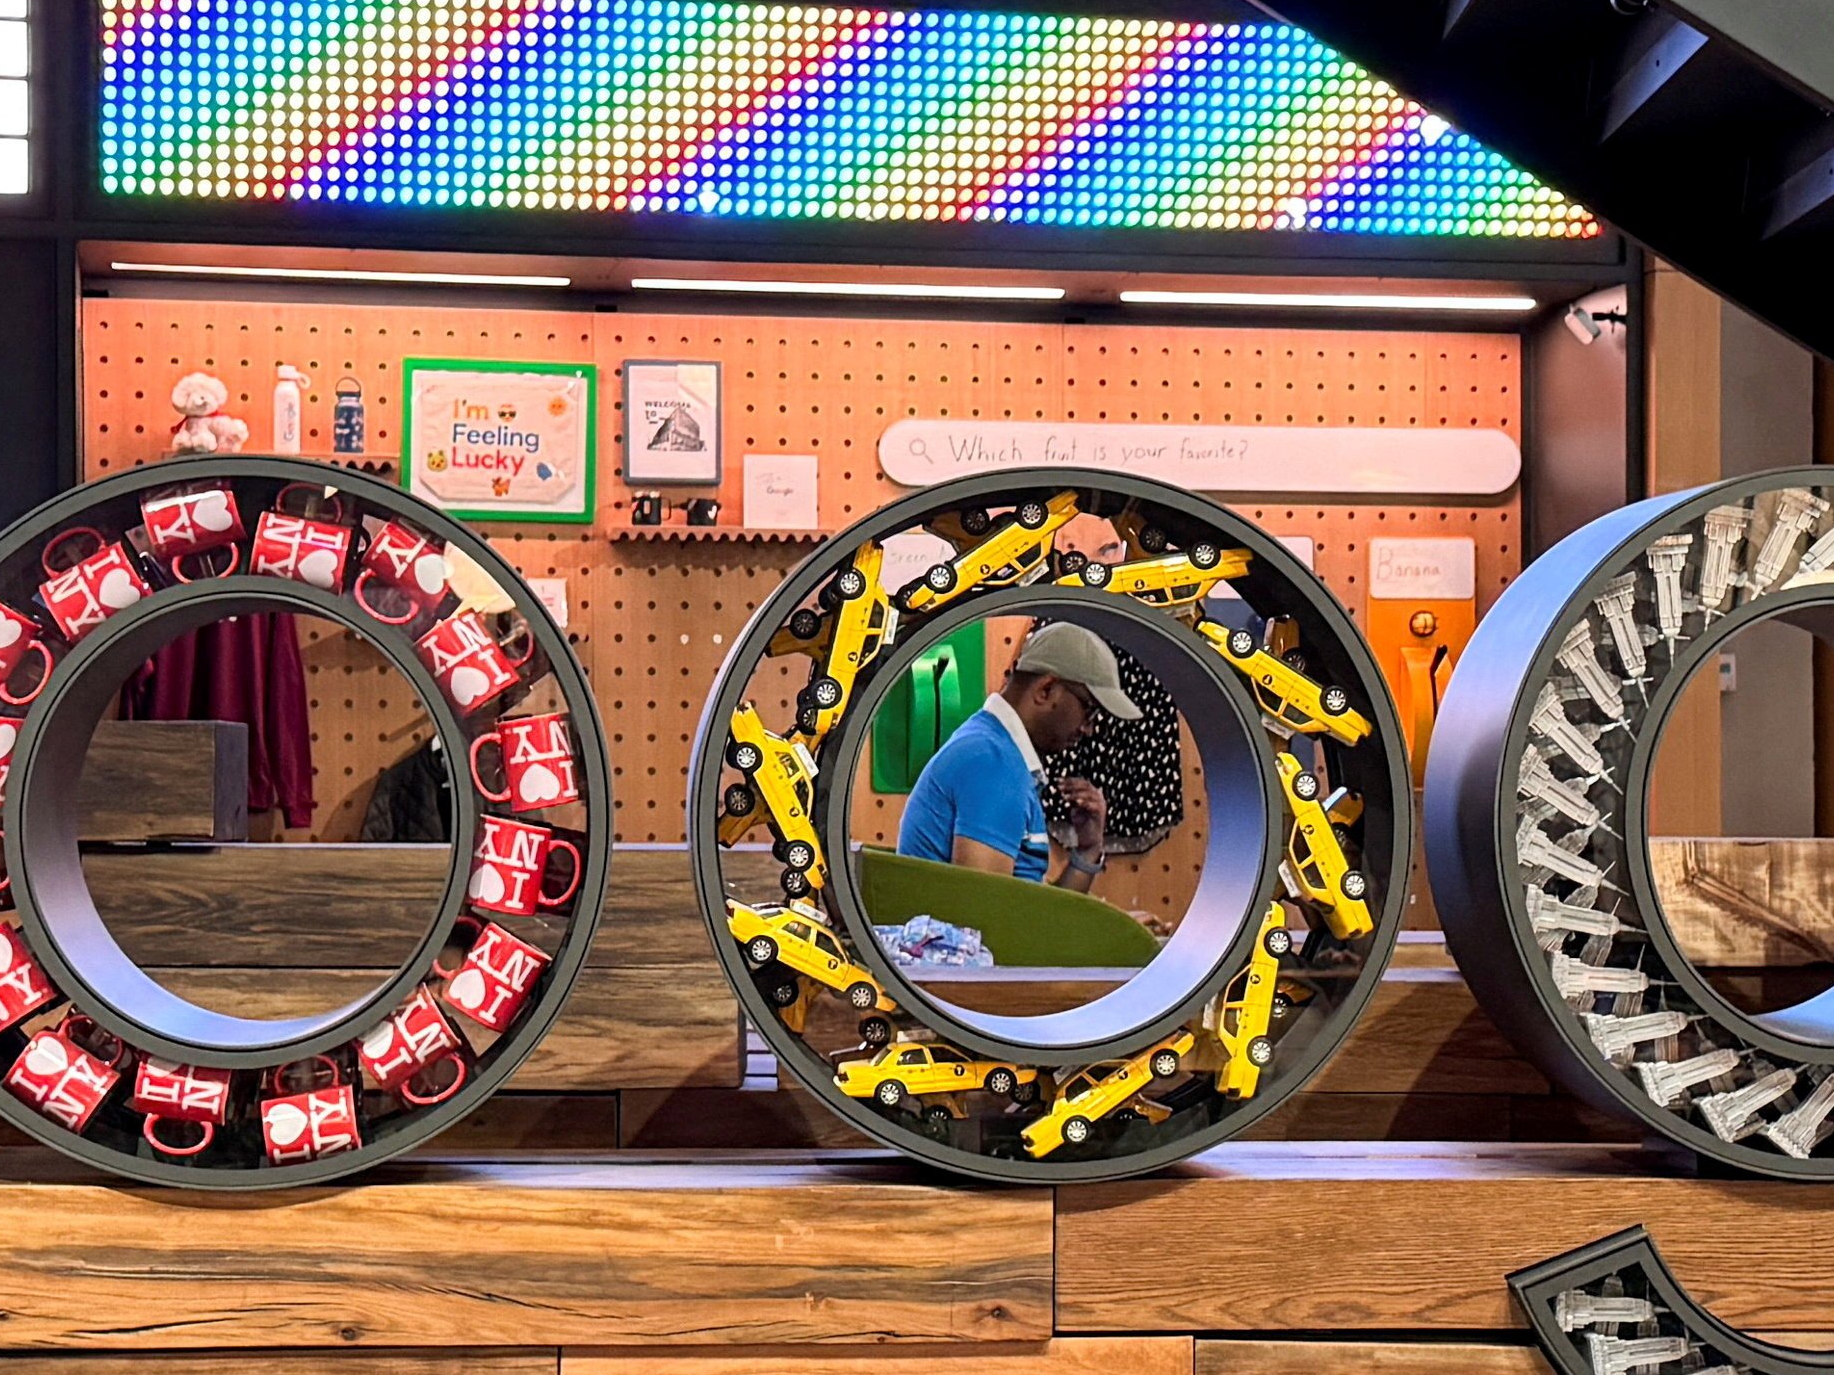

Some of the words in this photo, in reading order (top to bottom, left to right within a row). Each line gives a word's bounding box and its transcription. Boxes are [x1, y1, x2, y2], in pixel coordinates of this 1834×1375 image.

[452, 398, 490, 420] I'm
[452, 422, 540, 454] Feeling
[948, 434, 1023, 463] Which
[1093, 441, 1107, 461] is
[1121, 445, 1167, 465] your
[451, 445, 526, 476] Lucky
[304, 525, 345, 550] I
[83, 549, 121, 581] I
[1375, 547, 1441, 581] Banana
[45, 565, 108, 636] NY
[420, 610, 490, 677] NY
[477, 647, 512, 685] I
[558, 759, 580, 798] I
[474, 822, 546, 871] NY
[504, 870, 531, 911] I
[467, 928, 542, 994] NY
[478, 985, 514, 1025] I
[372, 1046, 414, 1081] I
[9, 1067, 50, 1102] I
[41, 1053, 109, 1130] NY
[140, 1079, 181, 1104] I
[272, 1143, 312, 1166] I
